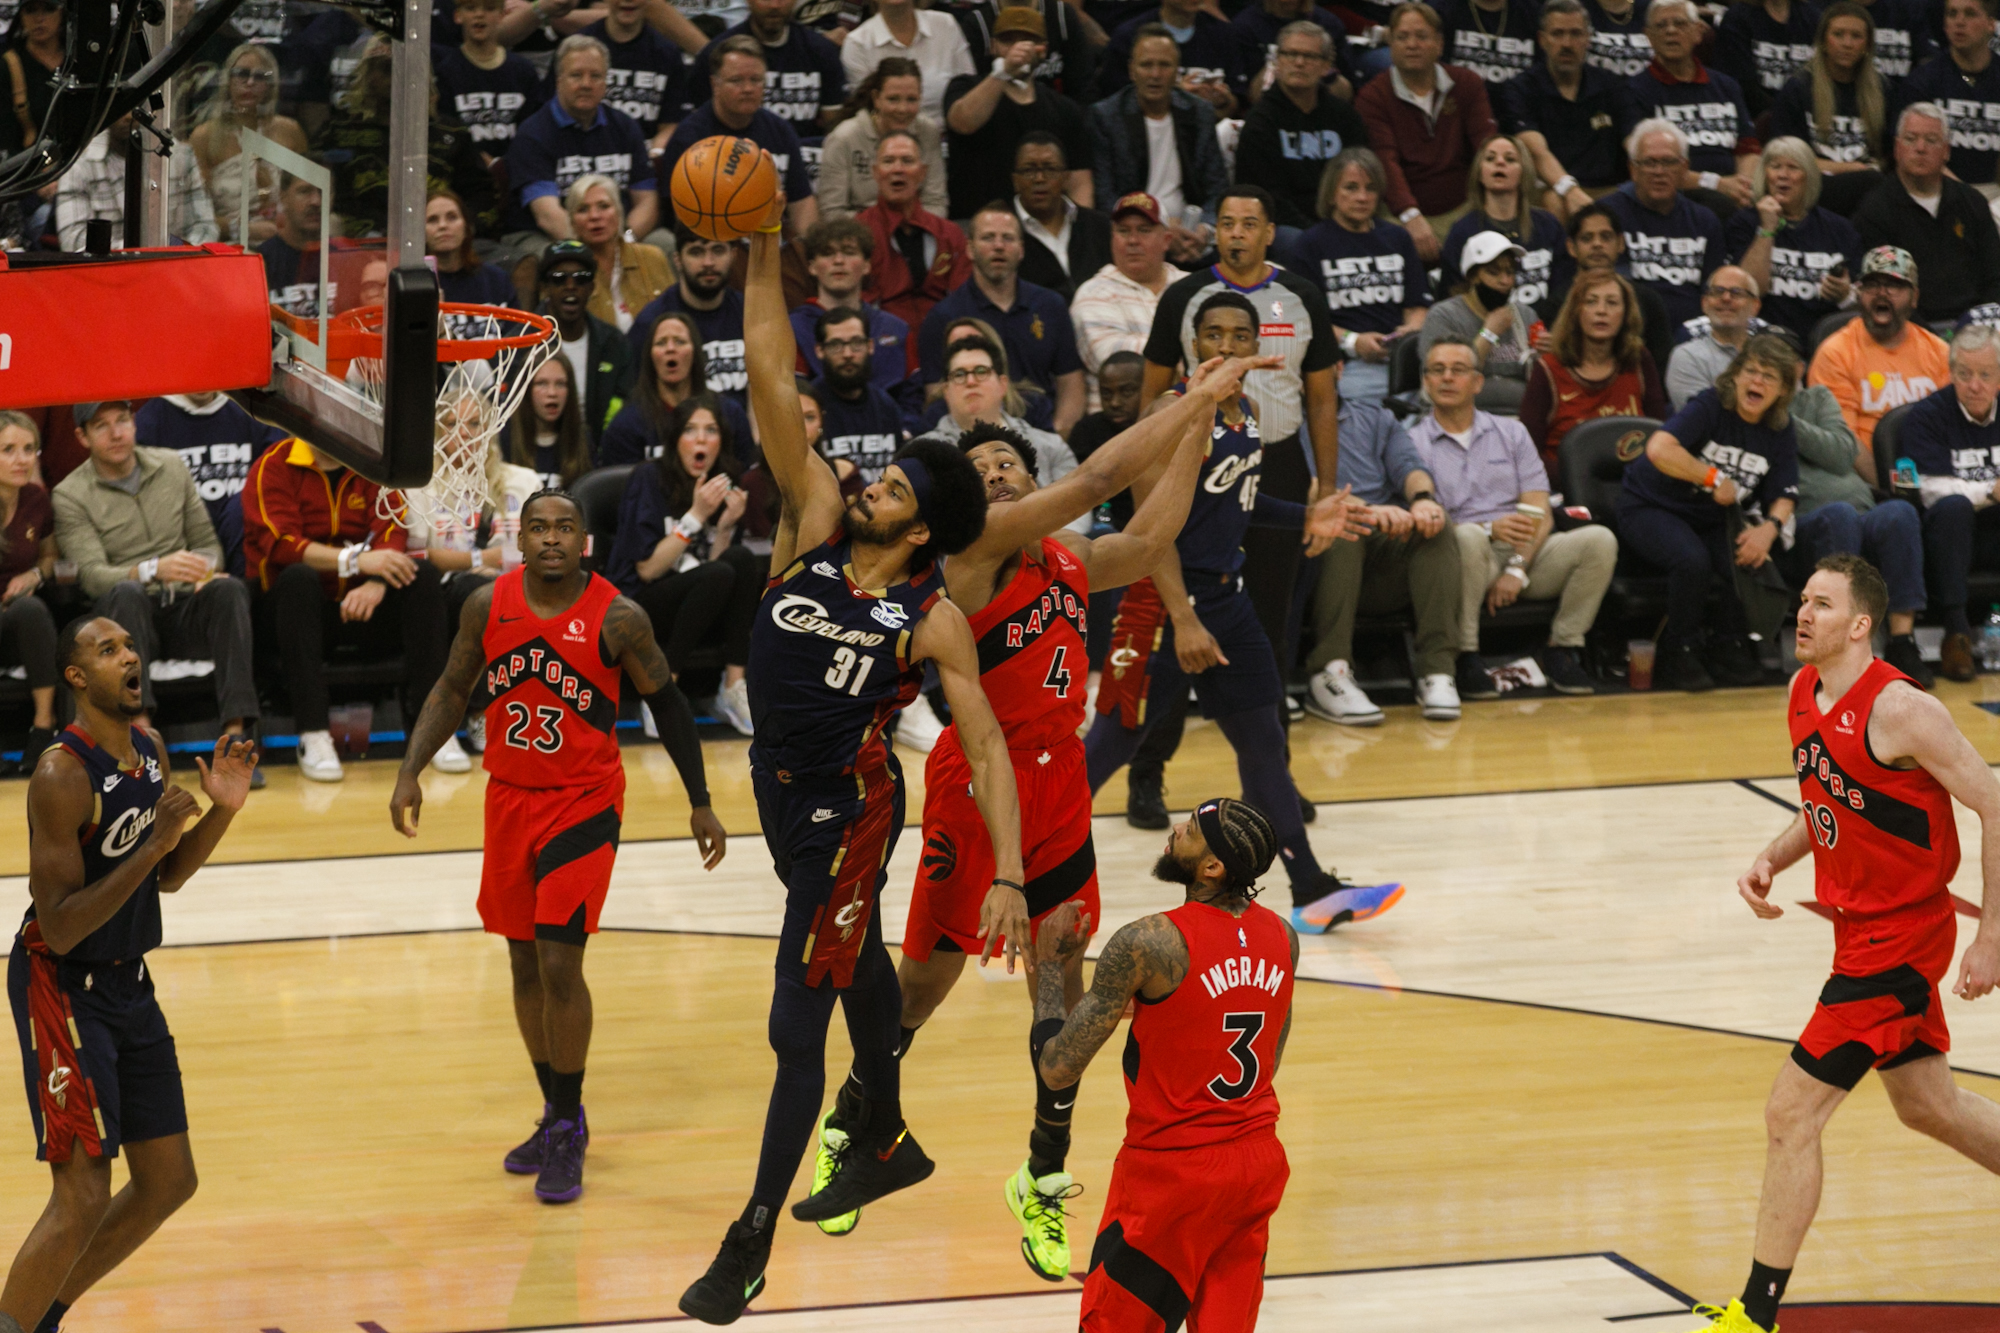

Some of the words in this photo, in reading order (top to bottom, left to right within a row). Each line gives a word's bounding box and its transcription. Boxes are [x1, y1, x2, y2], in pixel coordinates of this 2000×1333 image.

[1454, 29, 1492, 49] LET
[1496, 37, 1534, 56] EM
[781, 72, 821, 89] EM
[455, 92, 496, 112] LET
[1700, 101, 1738, 119] EM
[556, 155, 592, 174] LET
[595, 154, 632, 173] EM
[1669, 235, 1707, 255] EM
[1321, 256, 1373, 277] LET
[1260, 325, 1295, 337] Emirates
[1861, 376, 1939, 412] LAND
[209, 443, 252, 464] EM
[822, 437, 861, 456] LET
[1951, 449, 1987, 470] LET
[817, 560, 838, 575] NIKE
[771, 593, 886, 648] CLEVELAND
[872, 609, 903, 628] CLIFFS
[1006, 586, 1087, 648] RAPTOR
[488, 648, 592, 712] RAPTORS
[824, 646, 875, 697] 31
[1042, 646, 1071, 698] 4
[505, 701, 564, 754] 23
[1796, 742, 1864, 809] PTORS
[815, 808, 833, 817] NIKE
[1802, 800, 1838, 850] 19
[1200, 955, 1286, 999] INGRAM
[1207, 1011, 1266, 1102] 3
